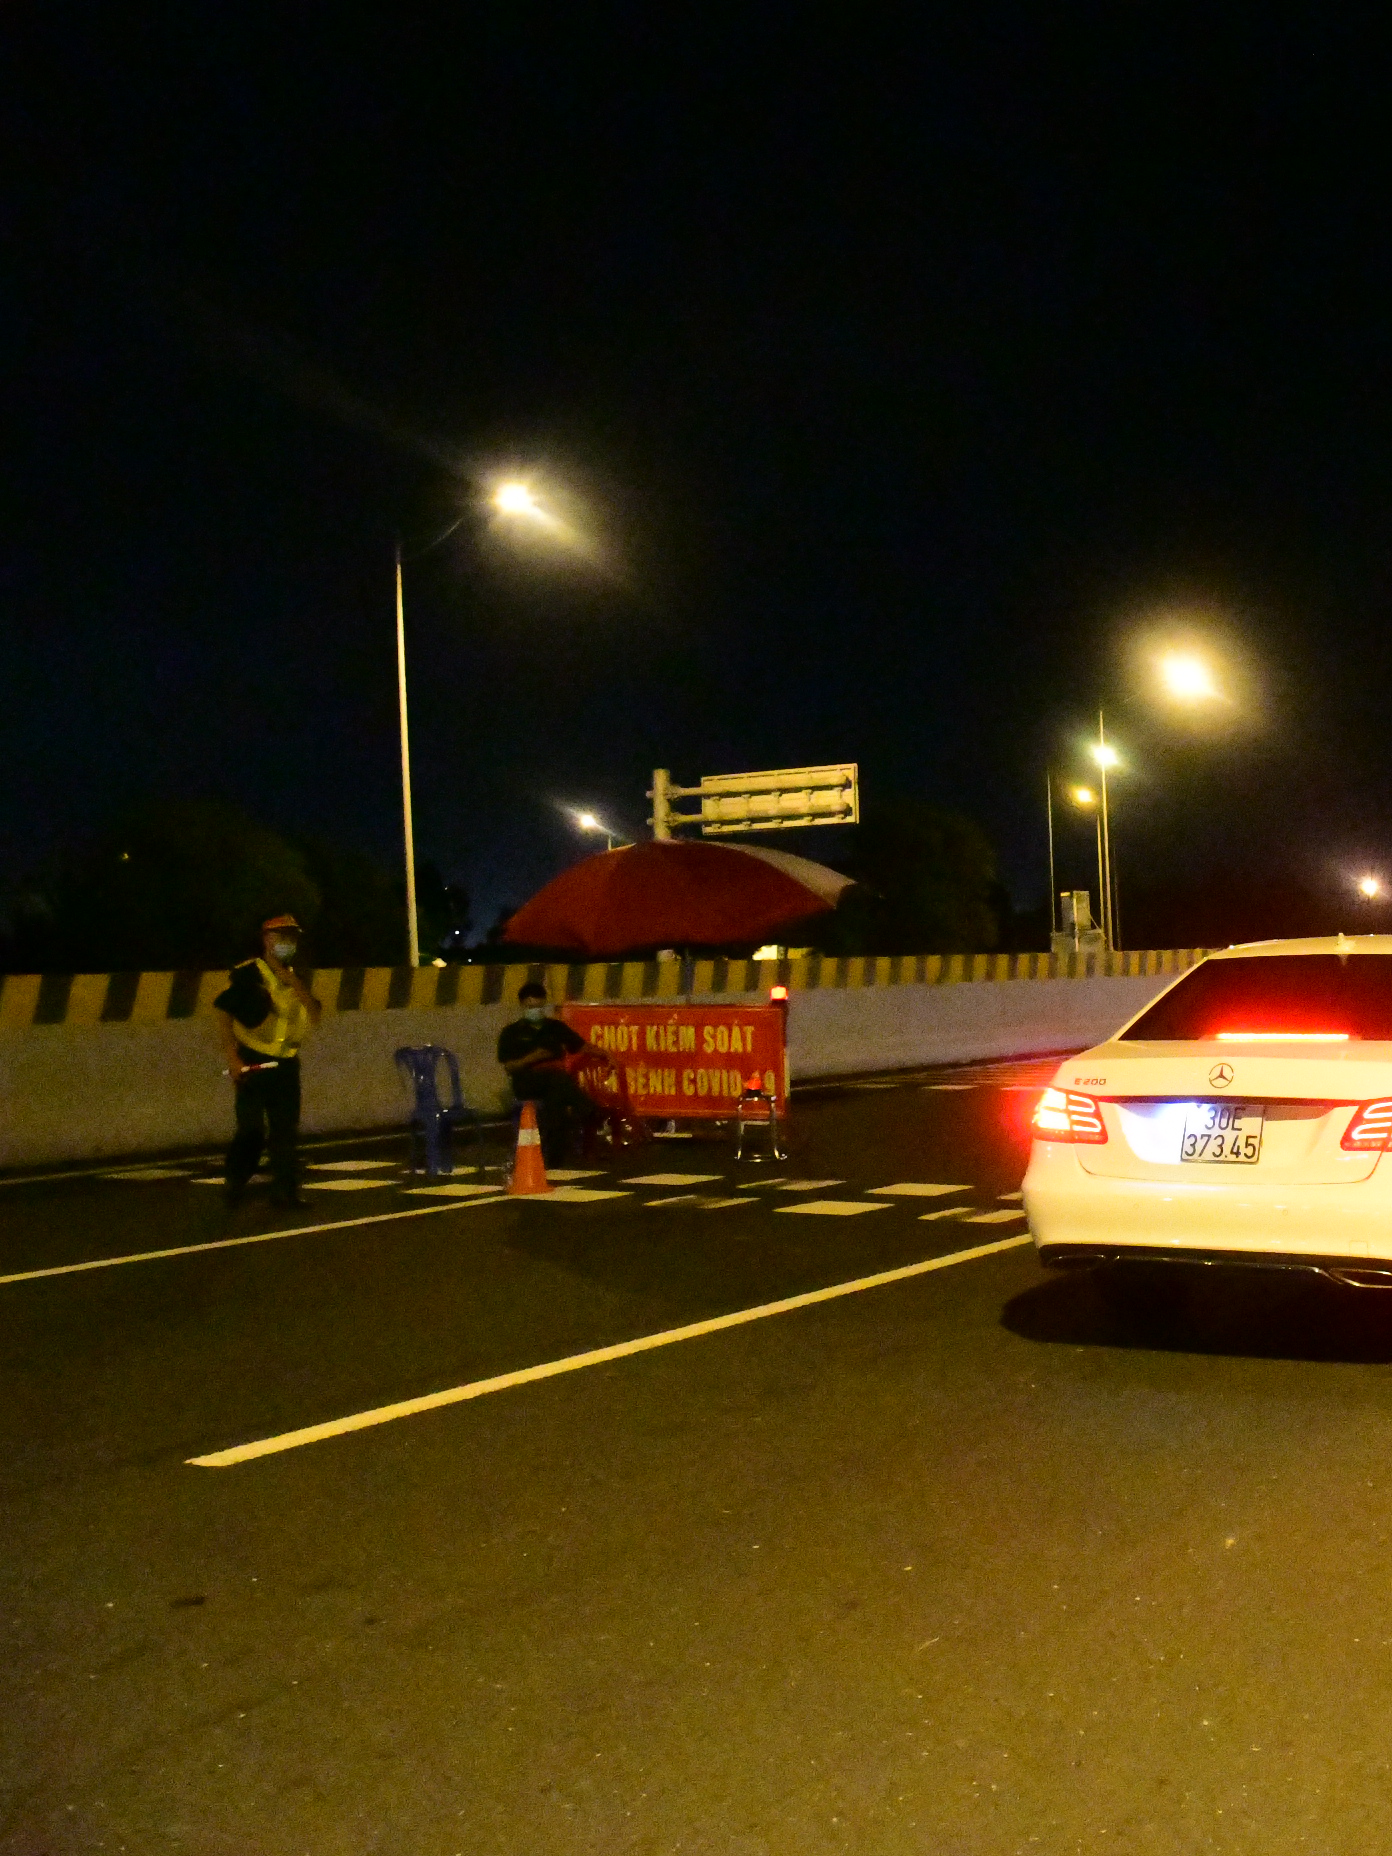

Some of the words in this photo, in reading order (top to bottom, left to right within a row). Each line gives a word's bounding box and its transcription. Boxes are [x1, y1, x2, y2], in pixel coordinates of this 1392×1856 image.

[589, 1014, 640, 1052] CHỐT
[645, 1013, 696, 1052] KIỂM
[702, 1018, 756, 1053] SOÁT
[1083, 1078, 1107, 1086] 200
[1205, 1106, 1246, 1131] 30E
[1184, 1133, 1258, 1159] 373.45
